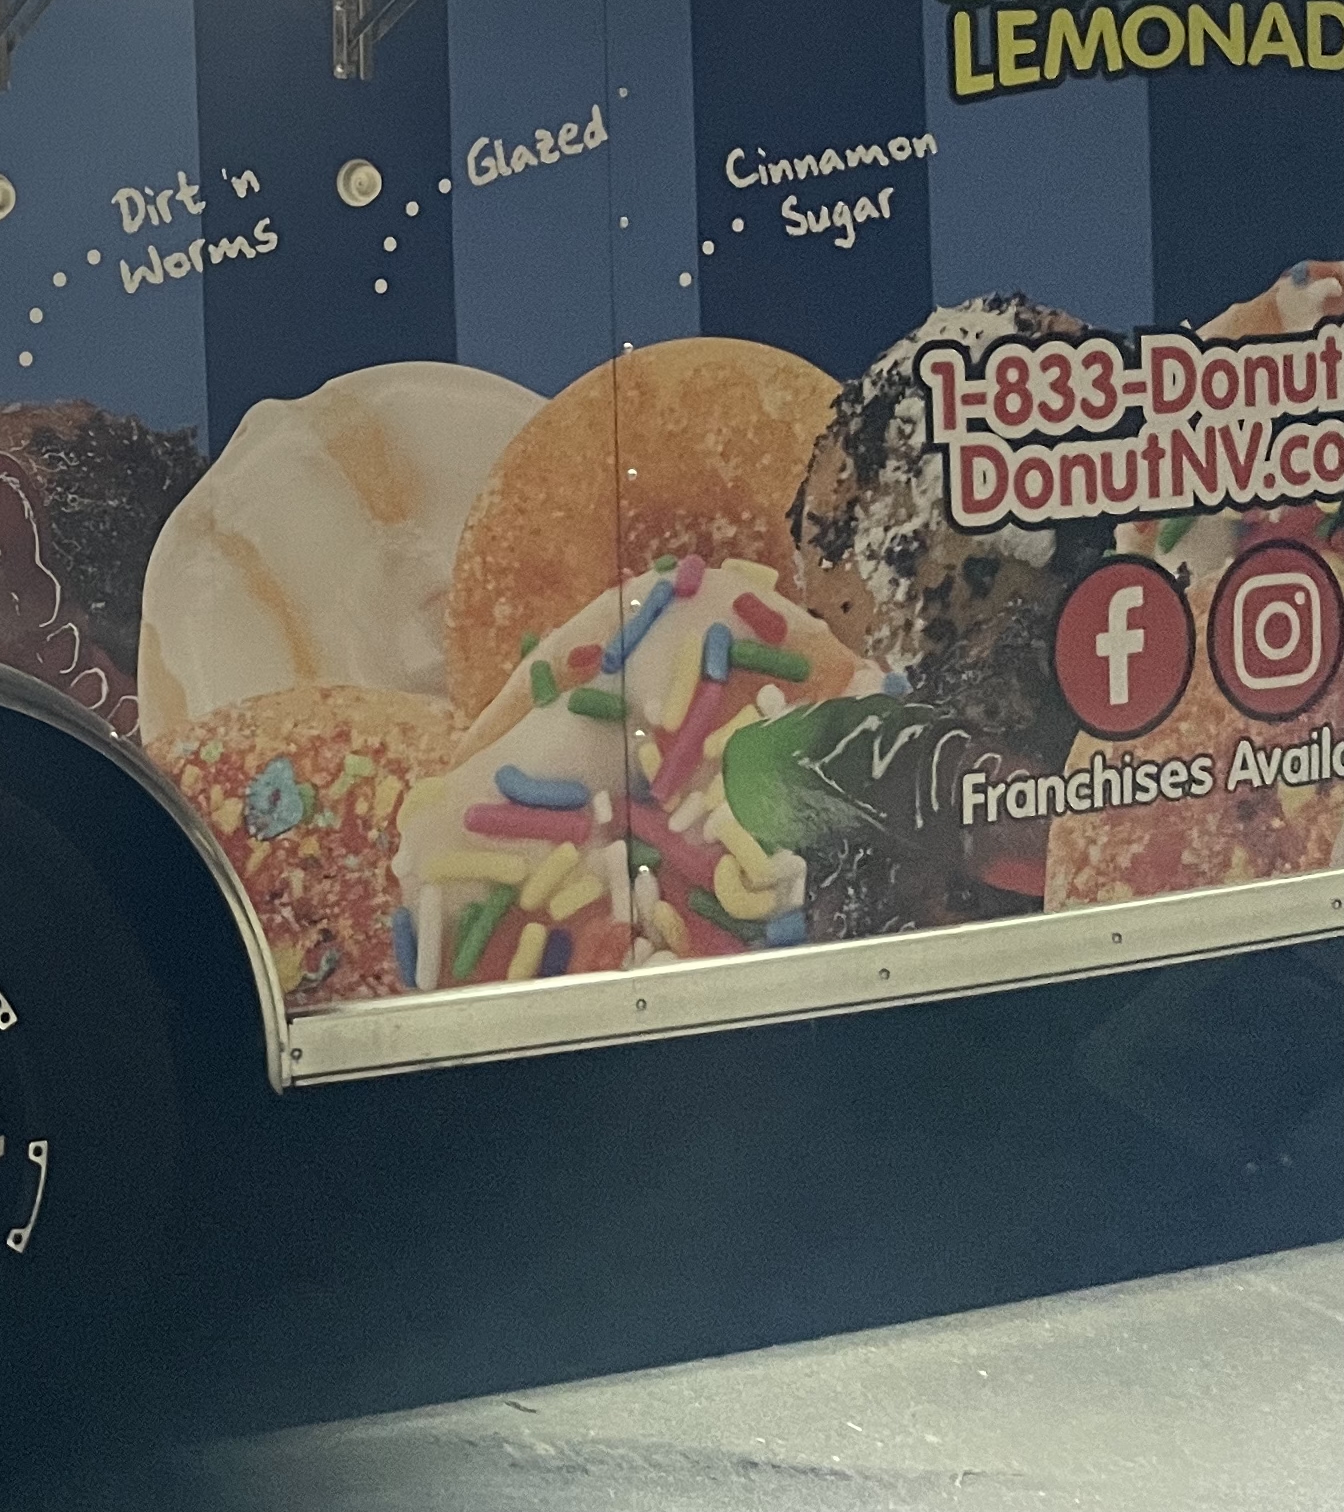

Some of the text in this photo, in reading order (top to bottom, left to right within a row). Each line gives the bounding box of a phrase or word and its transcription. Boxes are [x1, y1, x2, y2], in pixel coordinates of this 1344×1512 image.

[466, 104, 609, 187] Glazed
[725, 131, 938, 188] Cinnamon
[111, 171, 208, 234] Dirt
[781, 186, 895, 249] Sugar
[119, 218, 279, 294] Worms
[961, 750, 1213, 826] Franchises
